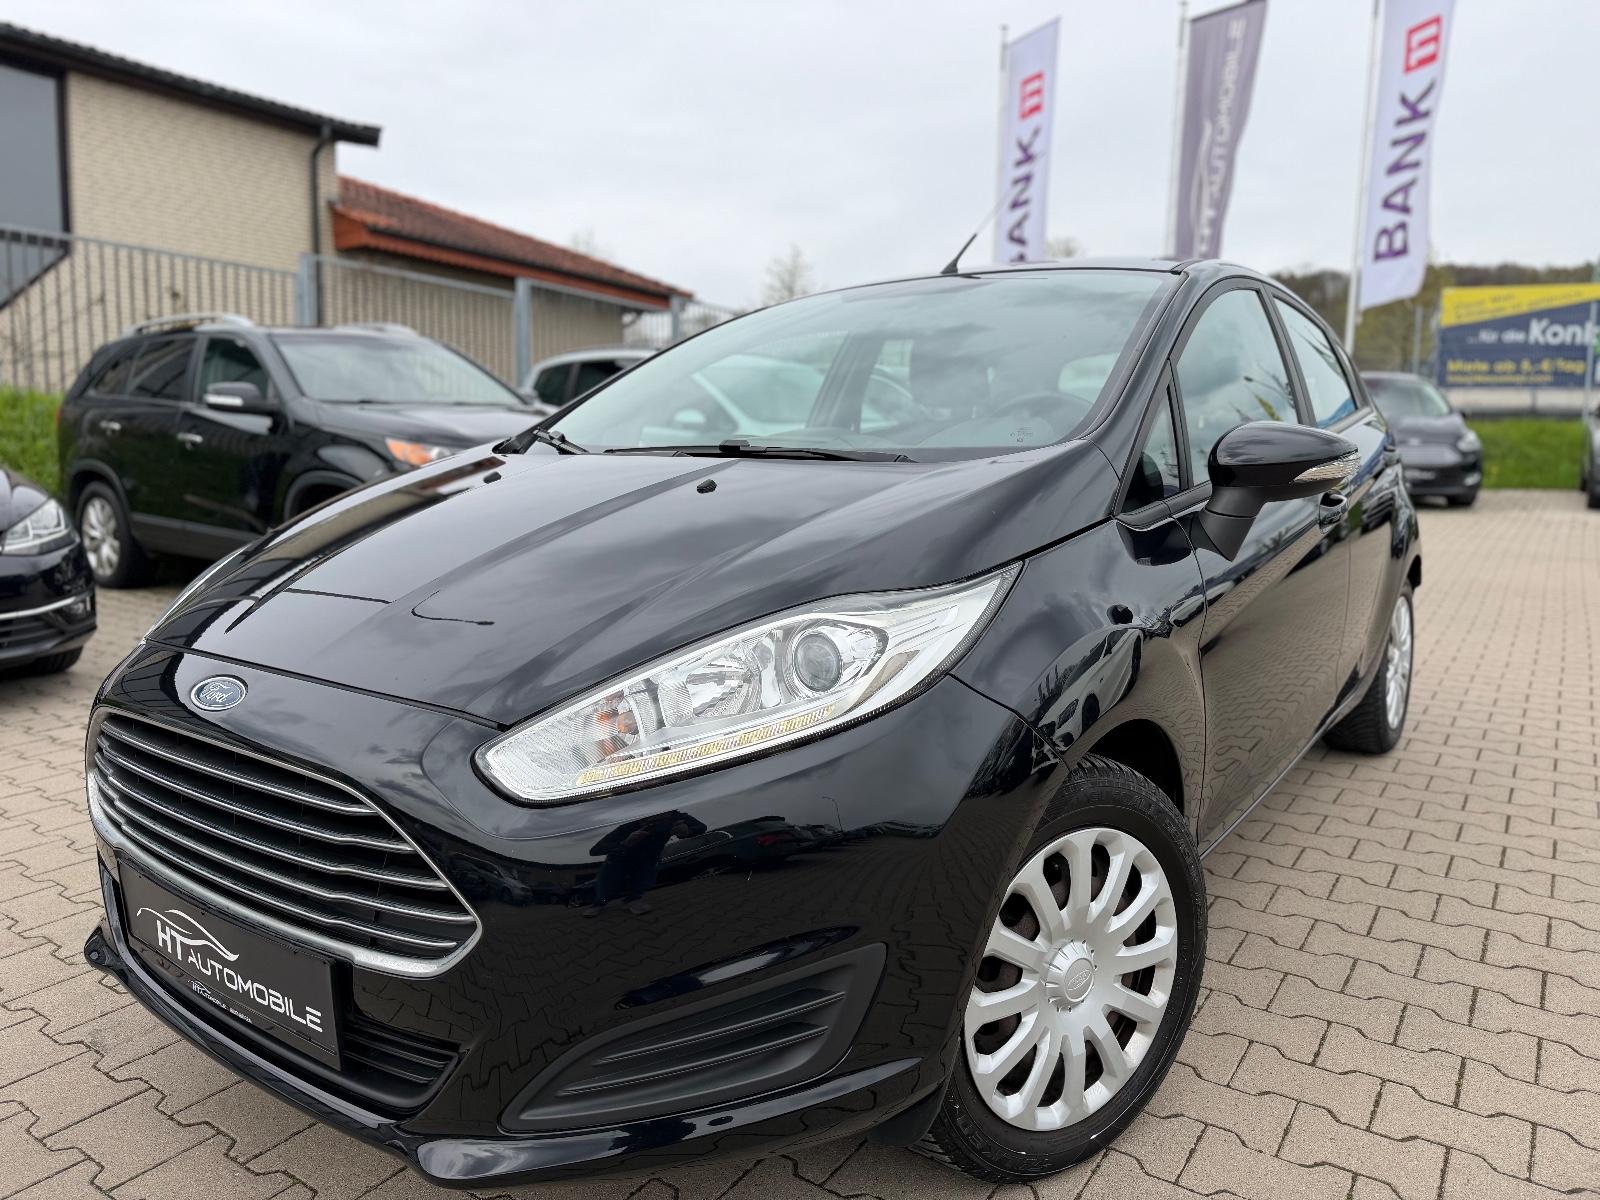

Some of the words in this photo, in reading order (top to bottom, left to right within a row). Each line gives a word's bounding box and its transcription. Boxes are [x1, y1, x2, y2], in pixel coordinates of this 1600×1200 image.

[1207, 18, 1247, 198] AUTOMOBILE
[1373, 79, 1436, 262] BANK
[199, 681, 234, 703] Ford
[156, 919, 184, 961] HT
[187, 948, 323, 1033] AUTOMOBILE
